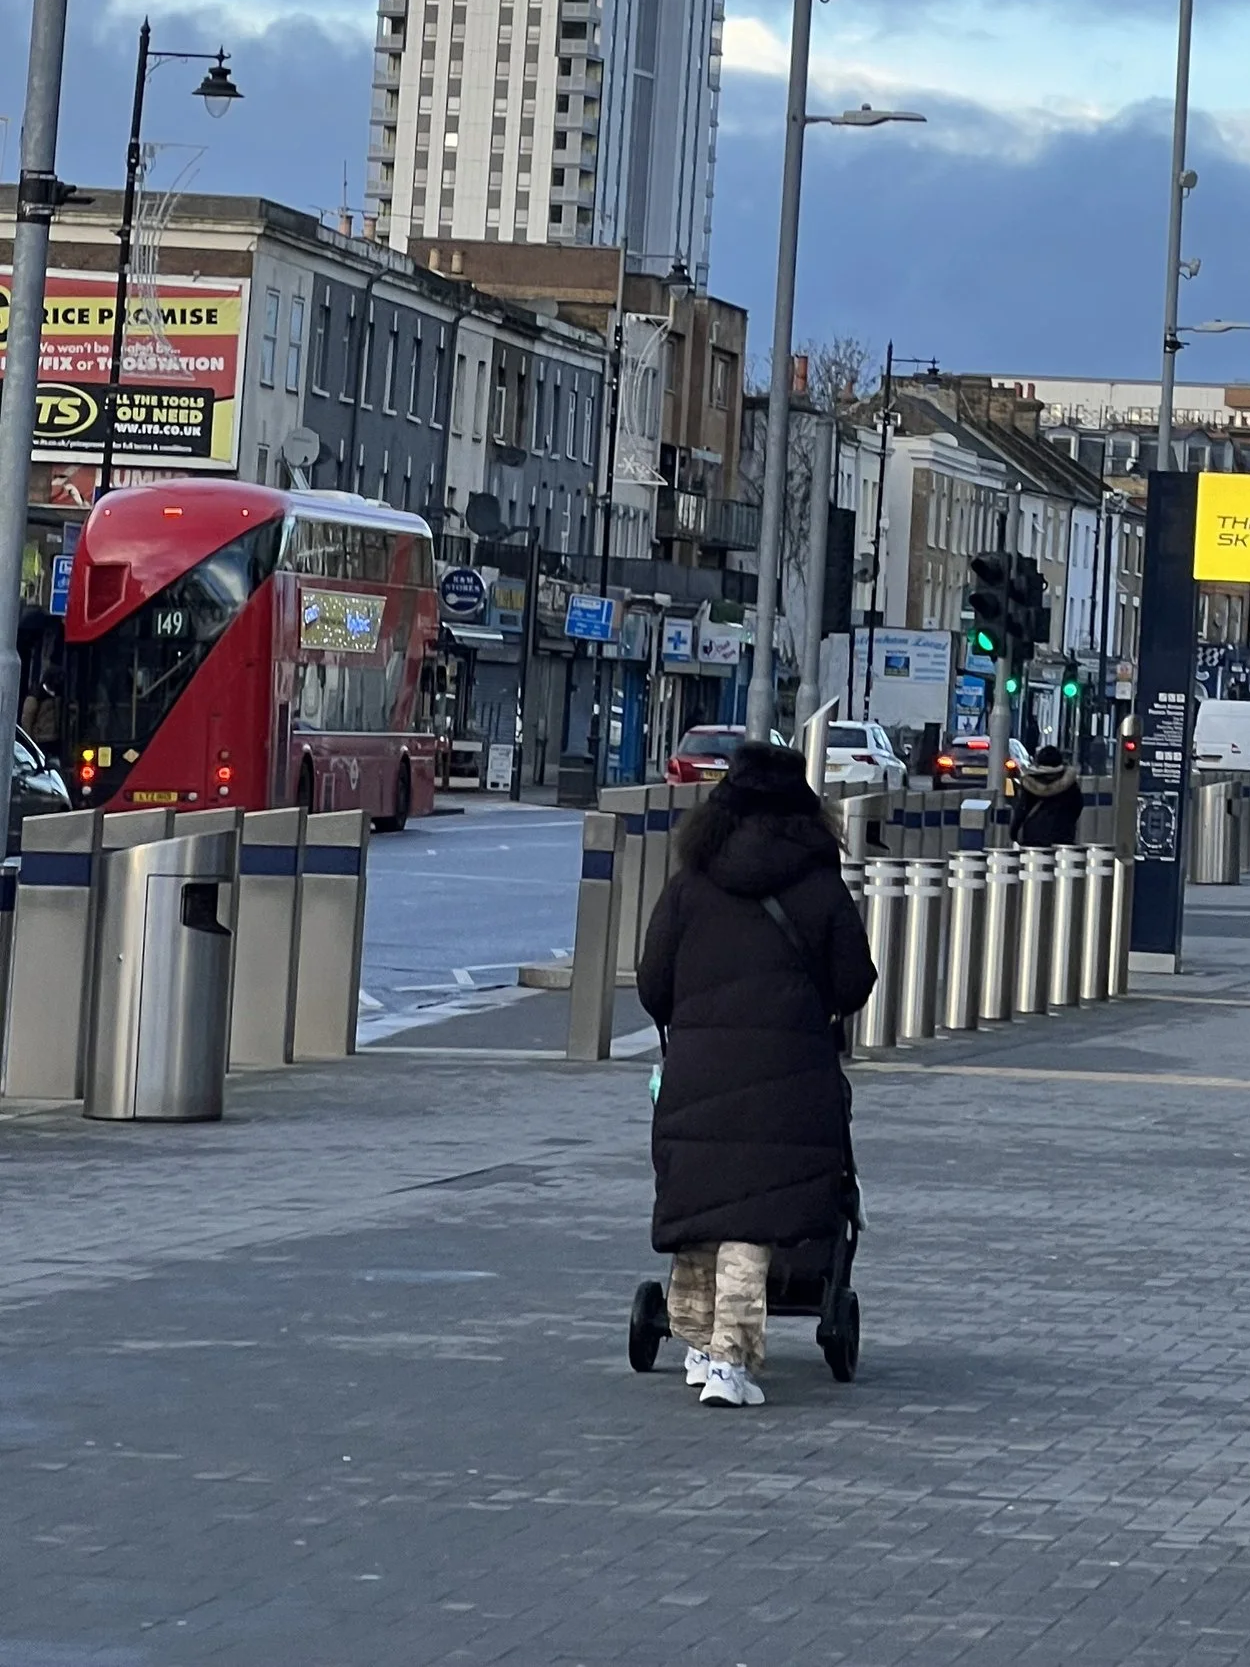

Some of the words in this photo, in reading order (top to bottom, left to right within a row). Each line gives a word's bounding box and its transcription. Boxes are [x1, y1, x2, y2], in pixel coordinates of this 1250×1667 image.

[42, 308, 90, 324] RICE
[98, 308, 218, 324] POMISE
[93, 340, 110, 354] be
[76, 360, 95, 371] or
[133, 395, 158, 406] THE
[161, 396, 205, 409] TOOLS
[36, 396, 81, 424] TS
[115, 406, 146, 423] OU
[152, 408, 204, 425] NEED
[114, 423, 201, 436] WW.ITS.CO.UK
[157, 611, 183, 636] 149
